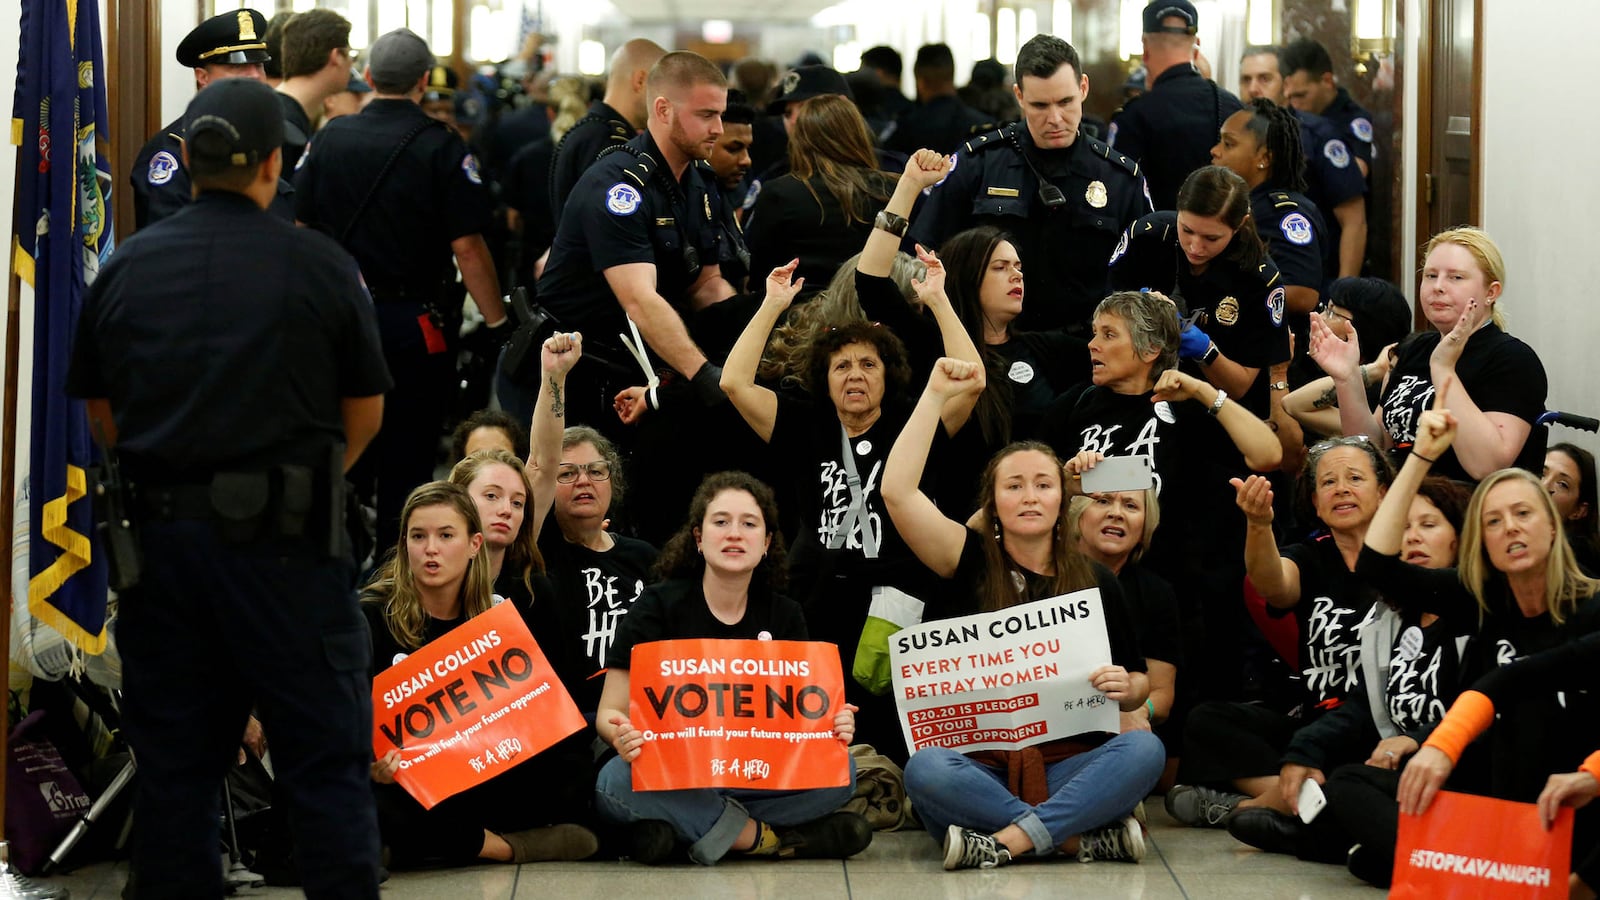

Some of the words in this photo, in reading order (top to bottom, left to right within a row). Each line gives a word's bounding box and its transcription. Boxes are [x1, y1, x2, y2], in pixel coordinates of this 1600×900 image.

[1125, 417, 1161, 469] A
[581, 567, 623, 609] BE
[898, 622, 980, 654] SUSAN
[988, 600, 1091, 639] COLLINS
[1307, 596, 1357, 646] BE
[383, 668, 435, 709] SUSAN
[434, 630, 502, 677] COLLINS
[660, 658, 726, 677] SUSAN
[729, 659, 811, 677] COLLINS
[901, 656, 962, 679] EVERY
[967, 648, 1015, 669] TIME
[1019, 639, 1061, 660] YOU
[379, 678, 478, 750] VOTE
[471, 647, 533, 701] NO
[904, 677, 976, 700] BETRAY
[981, 662, 1060, 689] WOMEN
[643, 682, 755, 721] VOTE
[765, 684, 830, 720] NO
[911, 707, 956, 723] $20.20
[960, 704, 973, 715] IS
[976, 696, 1036, 712] PLEDGED
[398, 757, 414, 770] Or
[412, 752, 426, 764] we
[424, 742, 443, 758] will
[440, 730, 464, 751] fund
[462, 719, 484, 741] your
[480, 705, 512, 728] future
[510, 681, 551, 711] opponent
[643, 729, 659, 742] Or
[660, 731, 675, 741] we
[676, 727, 696, 740] will
[698, 726, 724, 737] fund
[725, 730, 749, 741] your
[750, 727, 782, 739] future
[783, 730, 834, 744] opponent
[914, 726, 933, 737] TO
[936, 719, 973, 732] YOUR
[972, 723, 1042, 741] OPPONENT
[468, 756, 486, 773] BE
[485, 749, 502, 766] A
[496, 737, 522, 762] HERO
[710, 758, 727, 777] BE
[728, 757, 741, 778] A
[742, 758, 771, 780] HERO
